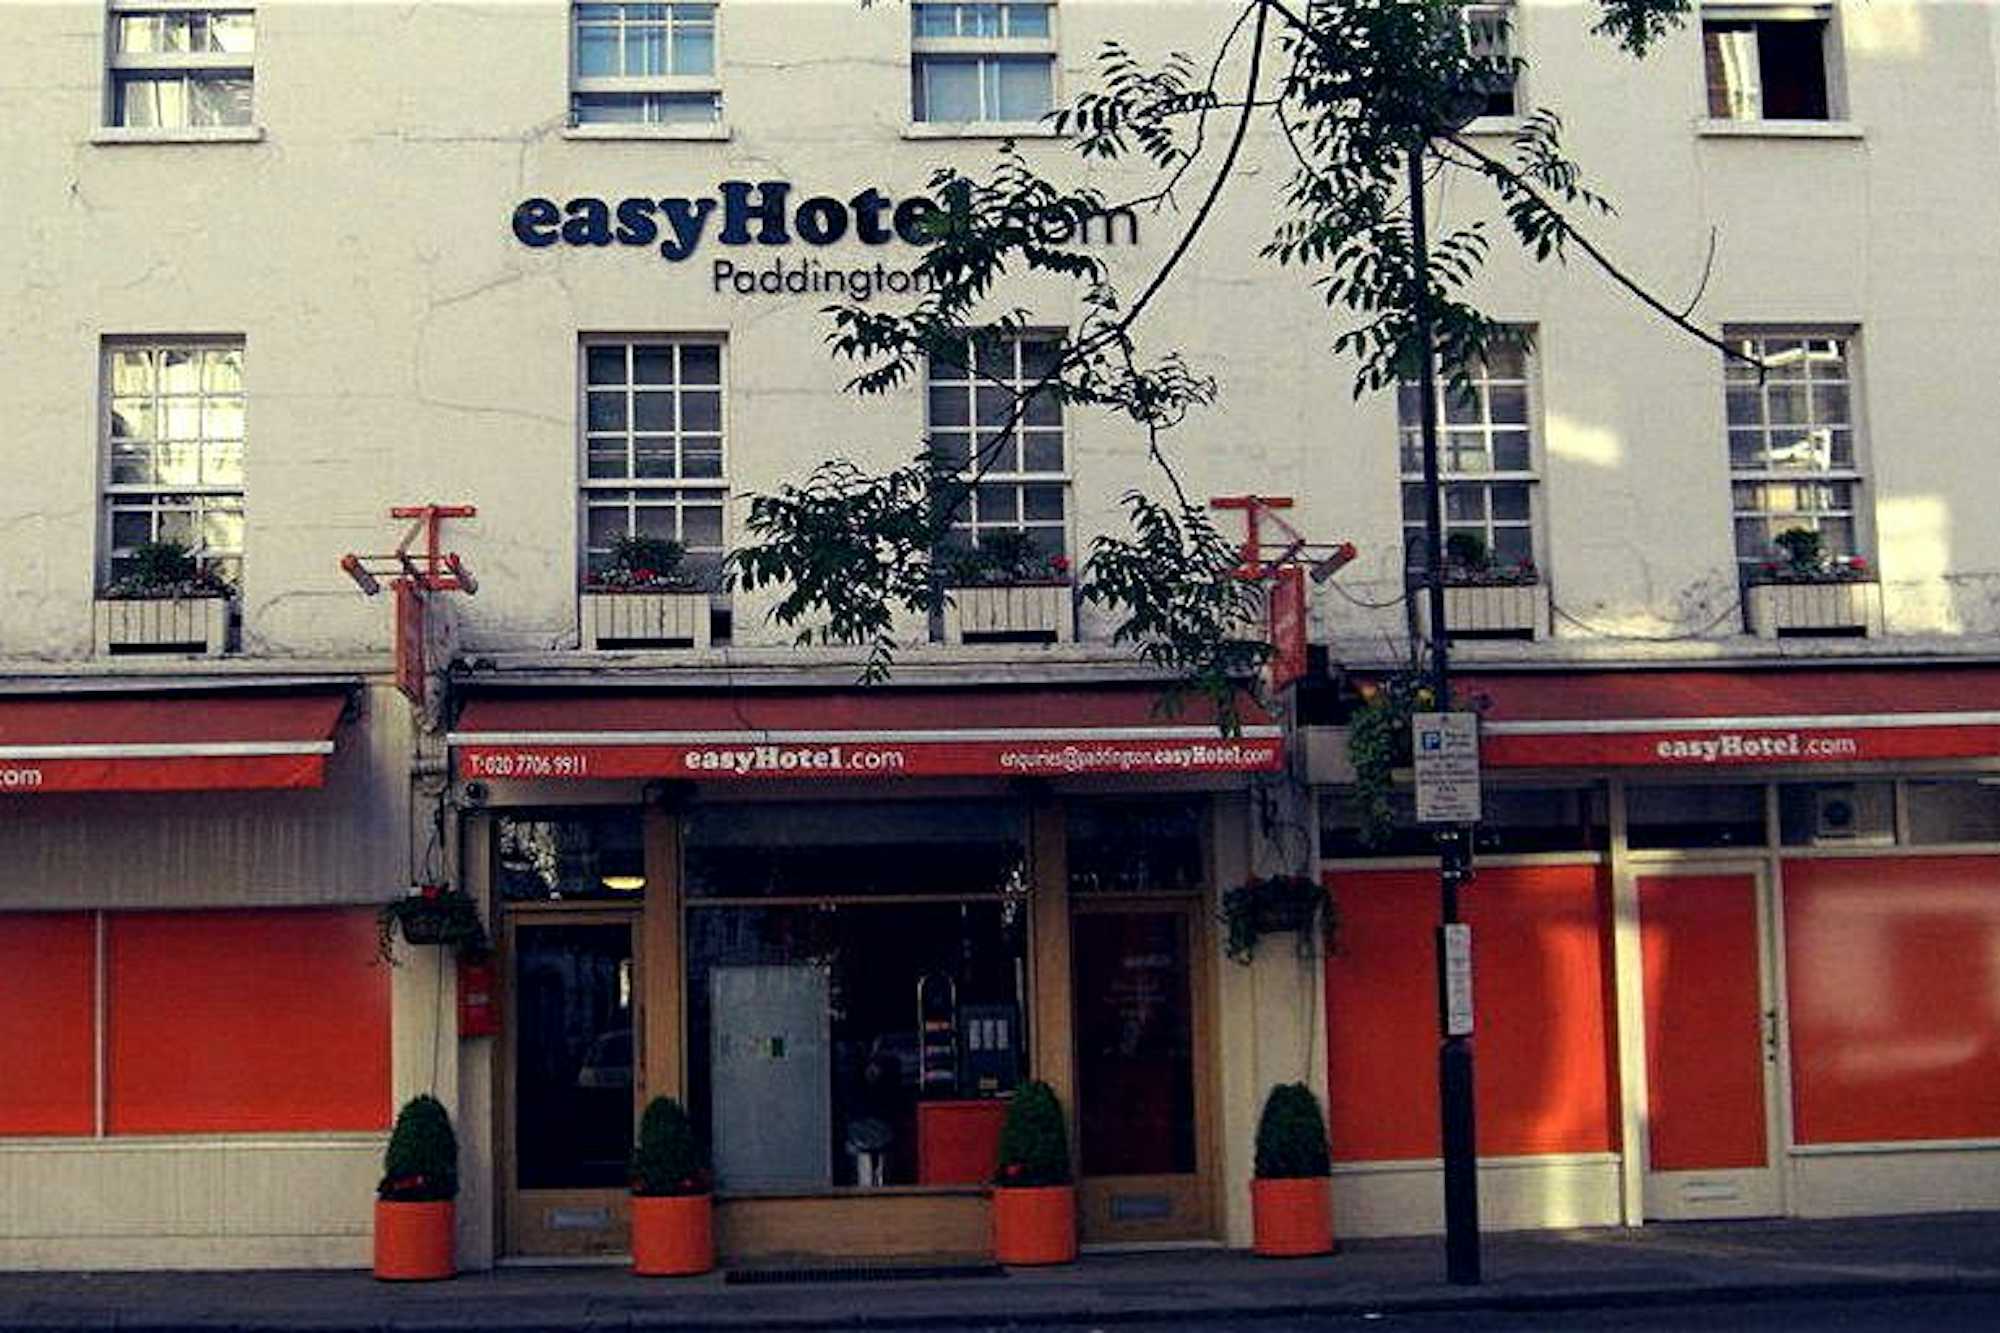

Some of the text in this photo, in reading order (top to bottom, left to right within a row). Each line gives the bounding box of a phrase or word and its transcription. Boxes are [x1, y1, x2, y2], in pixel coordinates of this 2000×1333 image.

[713, 256, 934, 298] Paddington
[685, 746, 905, 776] easyHotel.com
[1656, 733, 1857, 762] easyHotel.com
